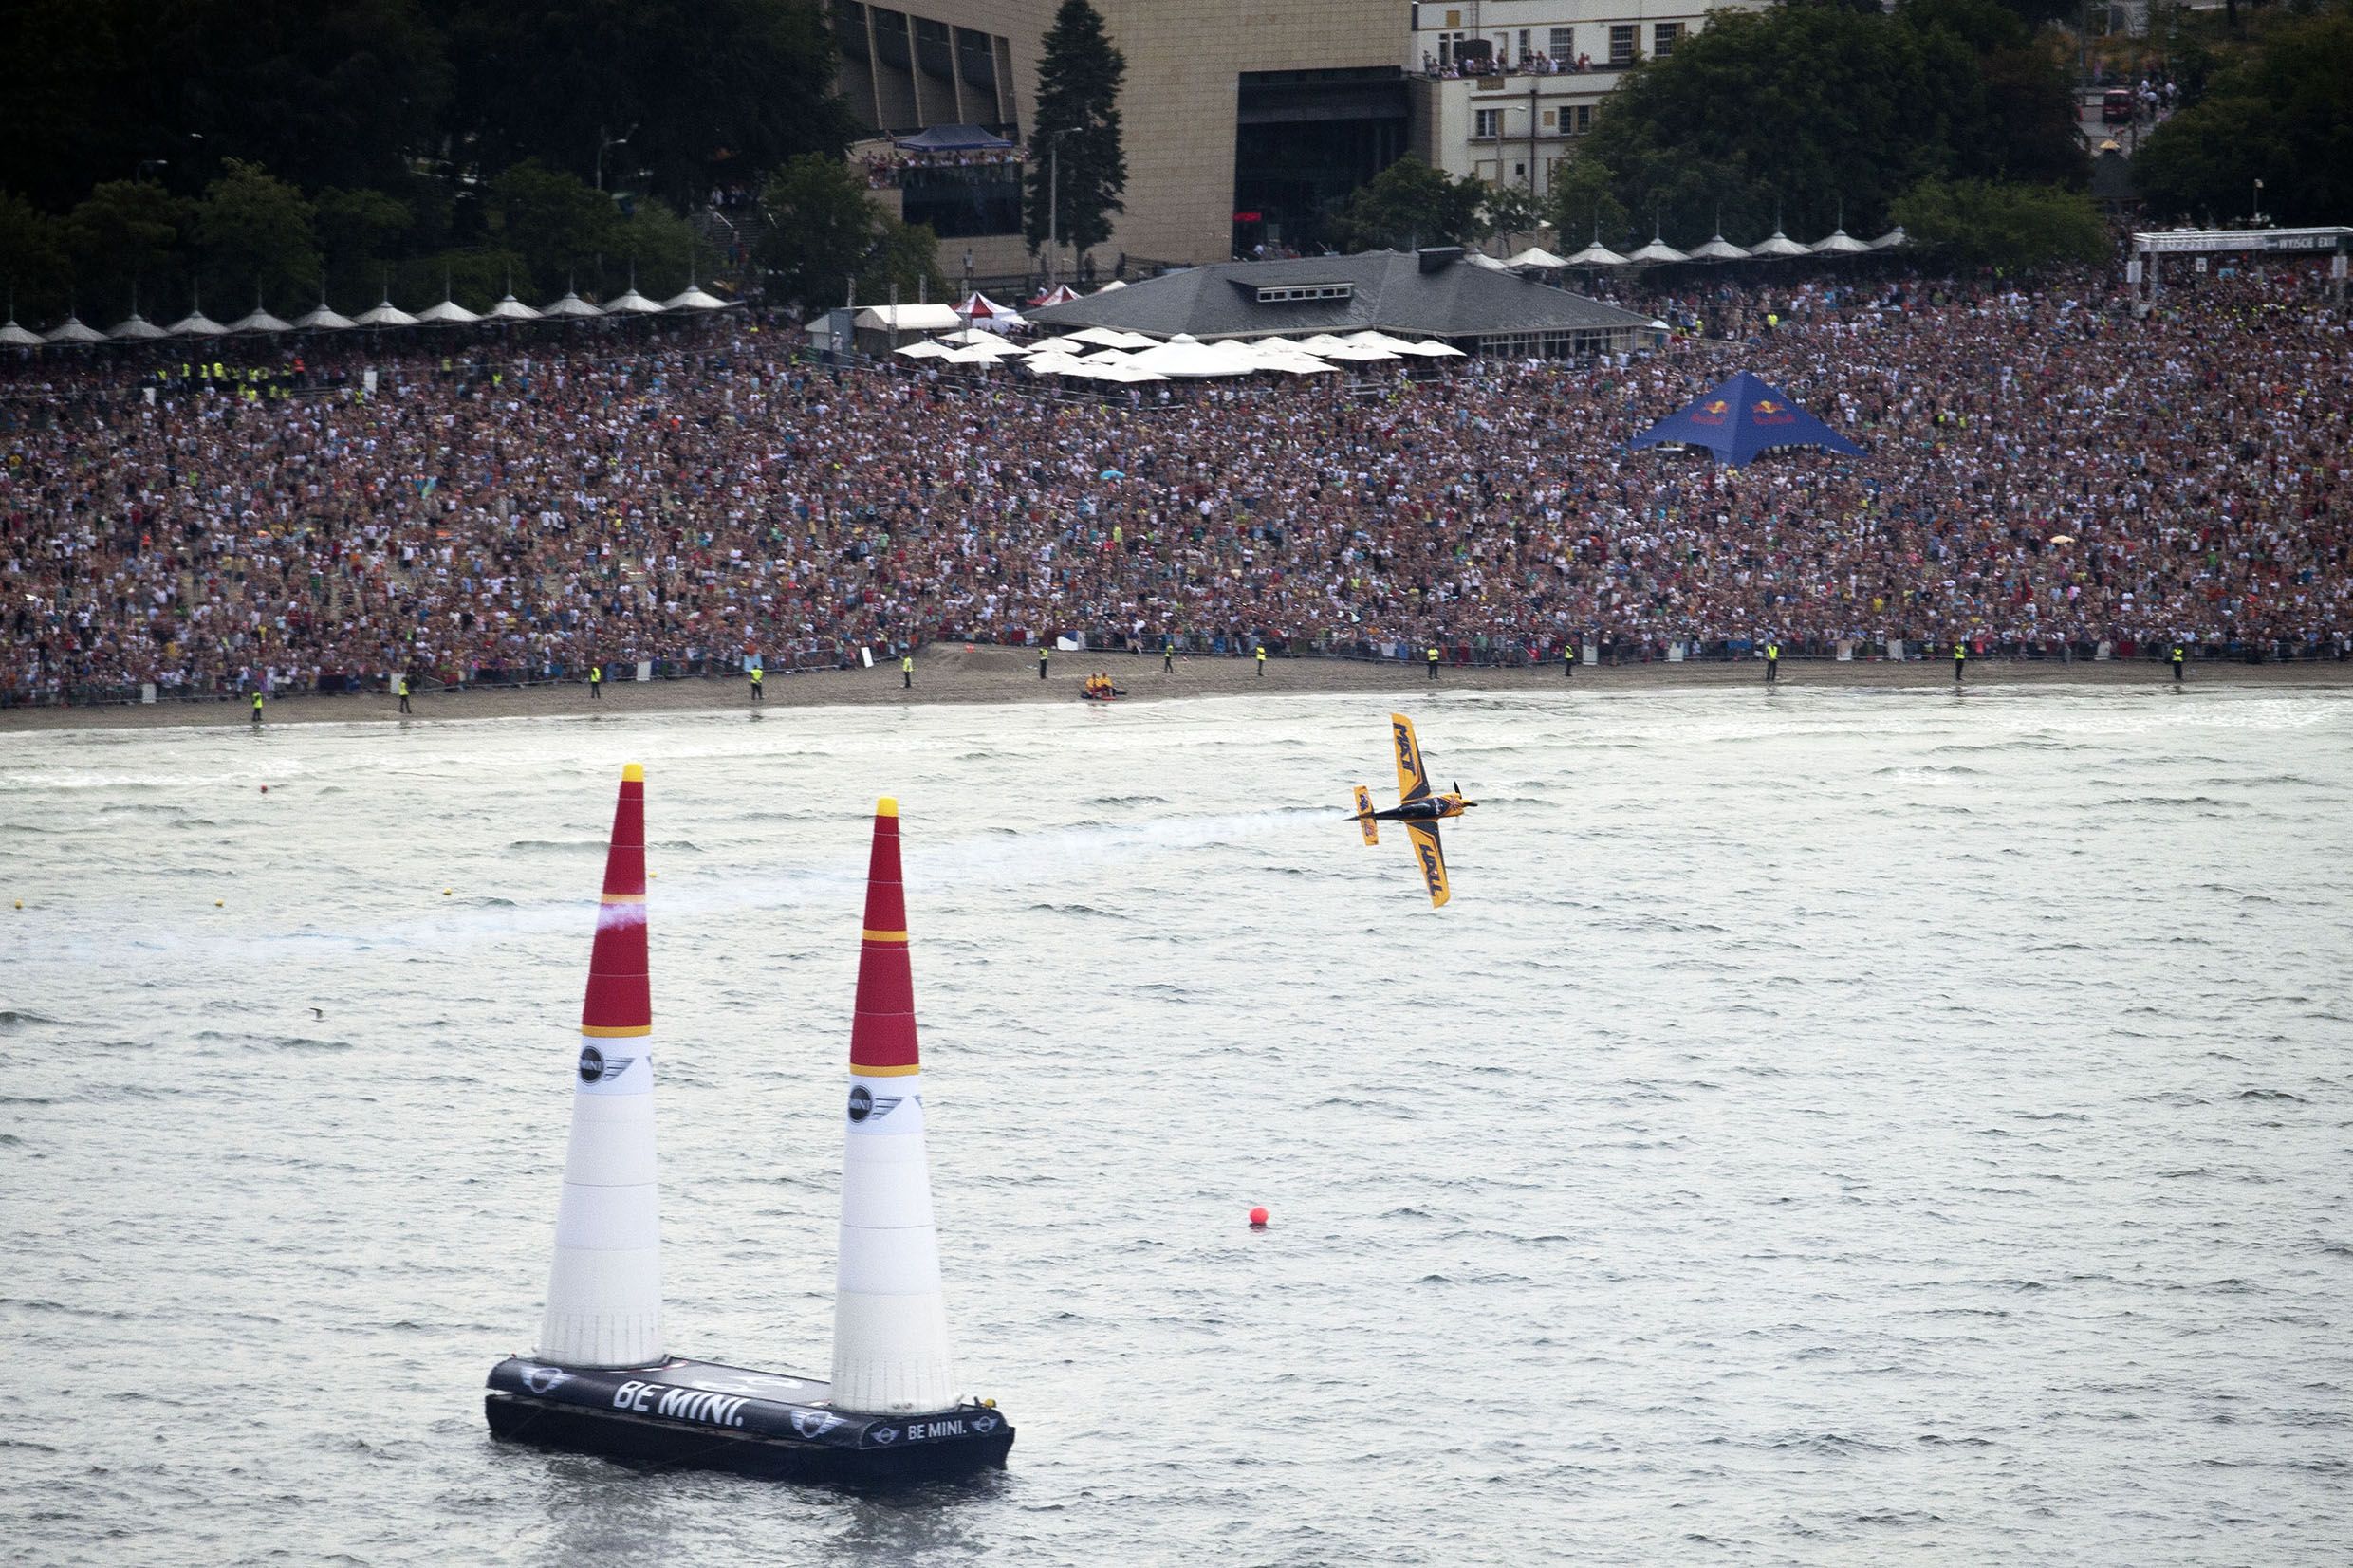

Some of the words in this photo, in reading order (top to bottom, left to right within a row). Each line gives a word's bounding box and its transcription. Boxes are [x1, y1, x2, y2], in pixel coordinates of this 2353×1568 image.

[1393, 722, 1417, 776] MATT
[1419, 843, 1442, 896] HALL
[613, 1380, 666, 1412] BE
[658, 1388, 750, 1427] MINI.
[908, 1424, 926, 1440] BE
[929, 1419, 967, 1438] MINI.
